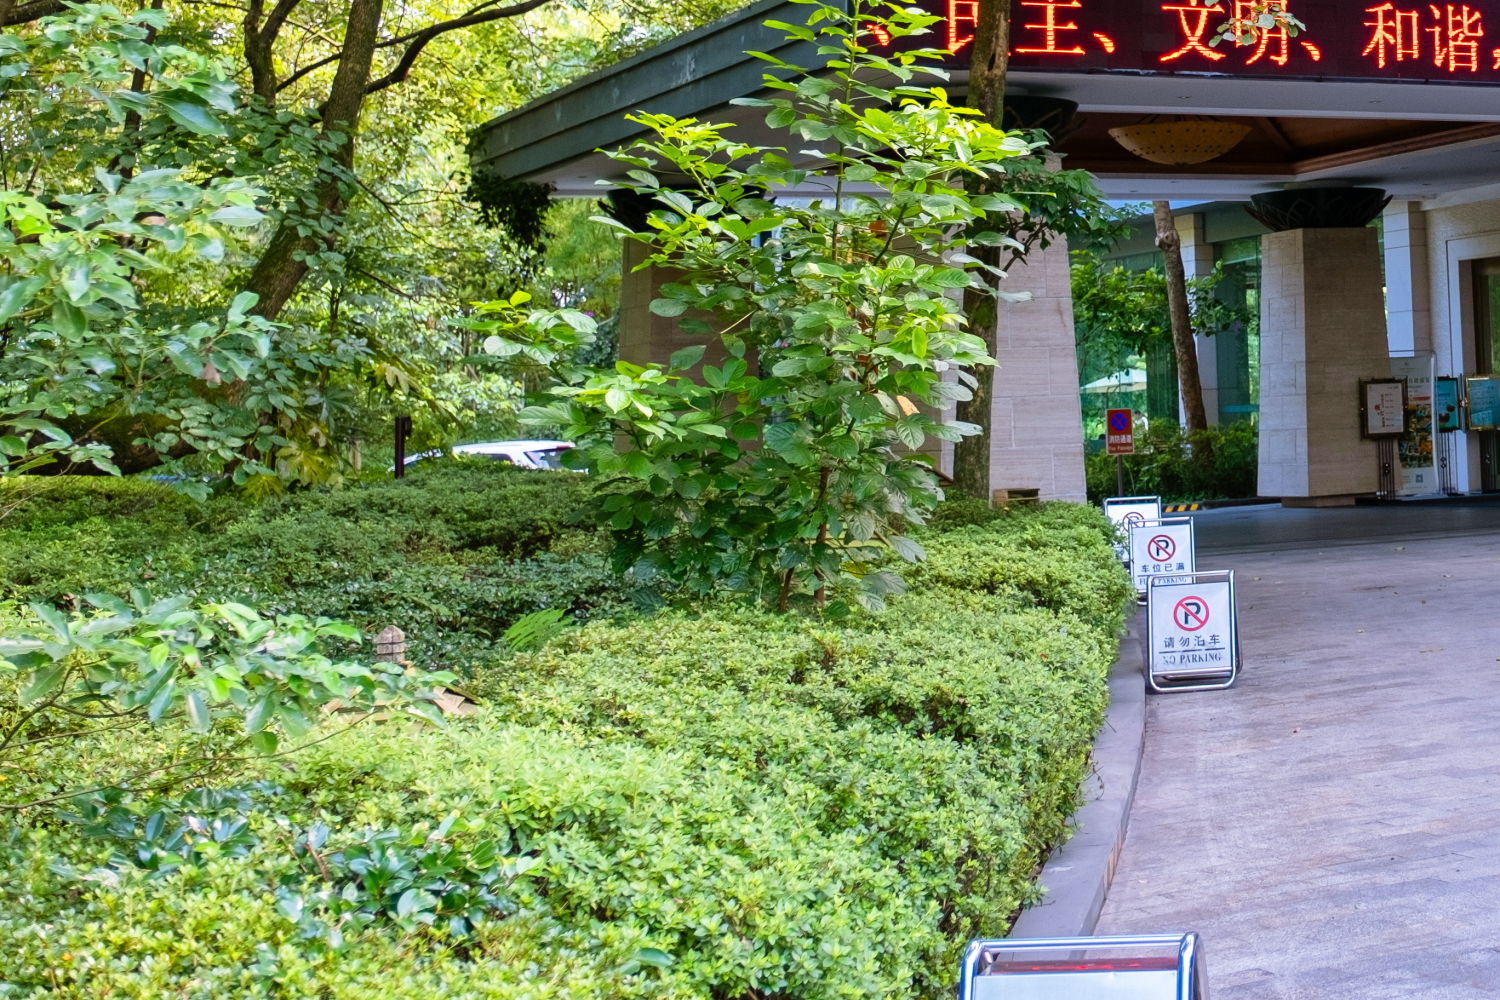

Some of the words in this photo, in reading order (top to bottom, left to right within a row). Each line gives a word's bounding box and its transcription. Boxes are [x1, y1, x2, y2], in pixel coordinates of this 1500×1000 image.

[1140, 562, 1185, 573] 车位已满
[1163, 634, 1221, 649] 请勿泊车
[1180, 652, 1222, 664] PARKING
